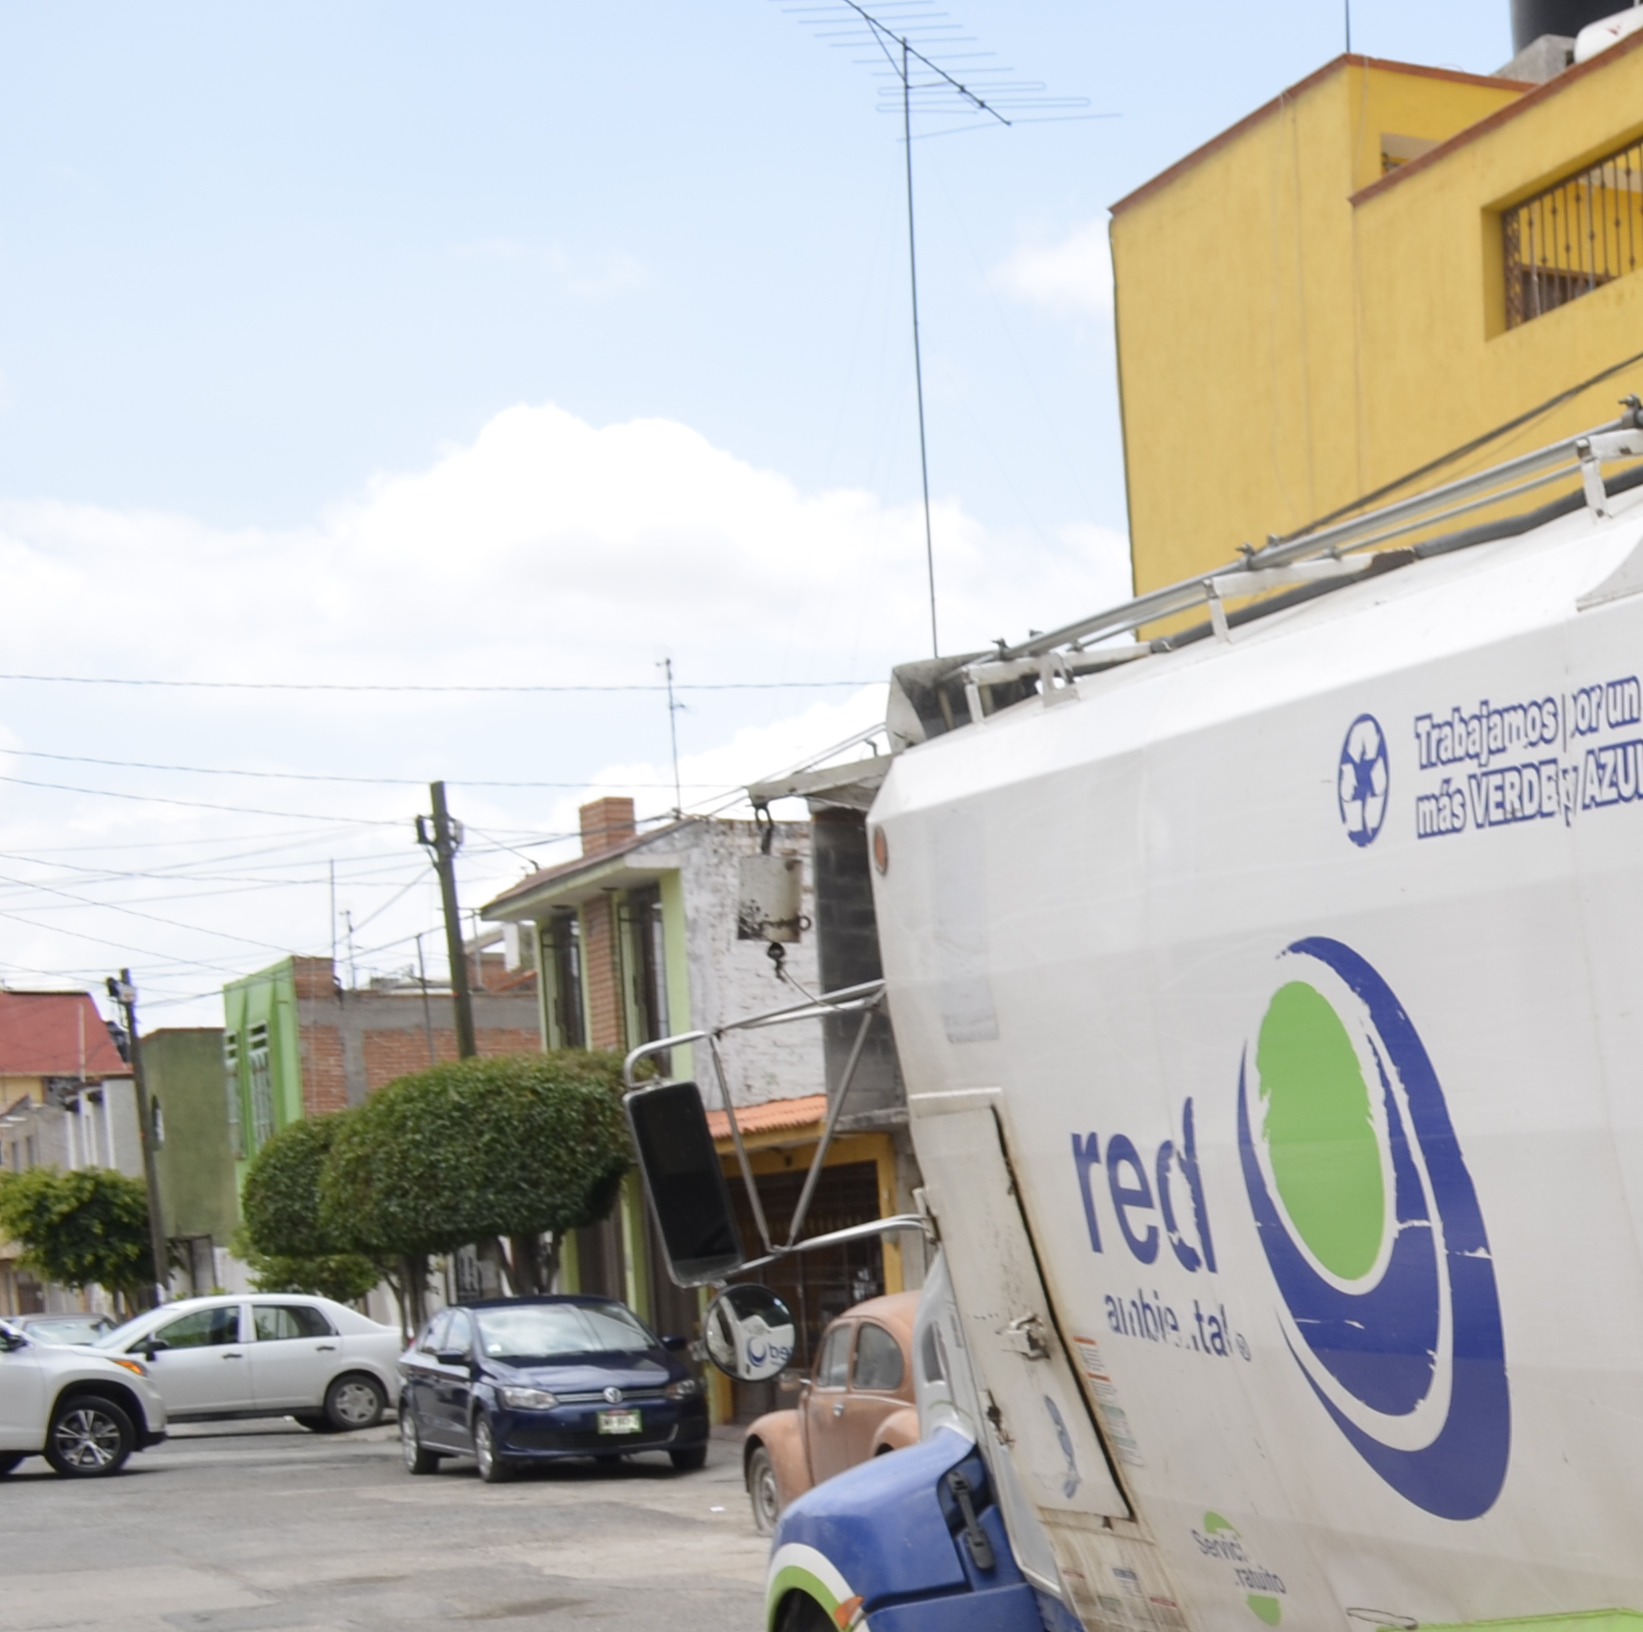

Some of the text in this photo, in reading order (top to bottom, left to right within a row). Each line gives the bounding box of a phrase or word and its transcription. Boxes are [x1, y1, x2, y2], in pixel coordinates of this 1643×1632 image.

[1414, 698, 1559, 770] Trabajamos
[1606, 674, 1641, 730] un
[1416, 777, 1467, 840] más
[1467, 757, 1559, 830] VERDE
[1070, 1096, 1218, 1274] red
